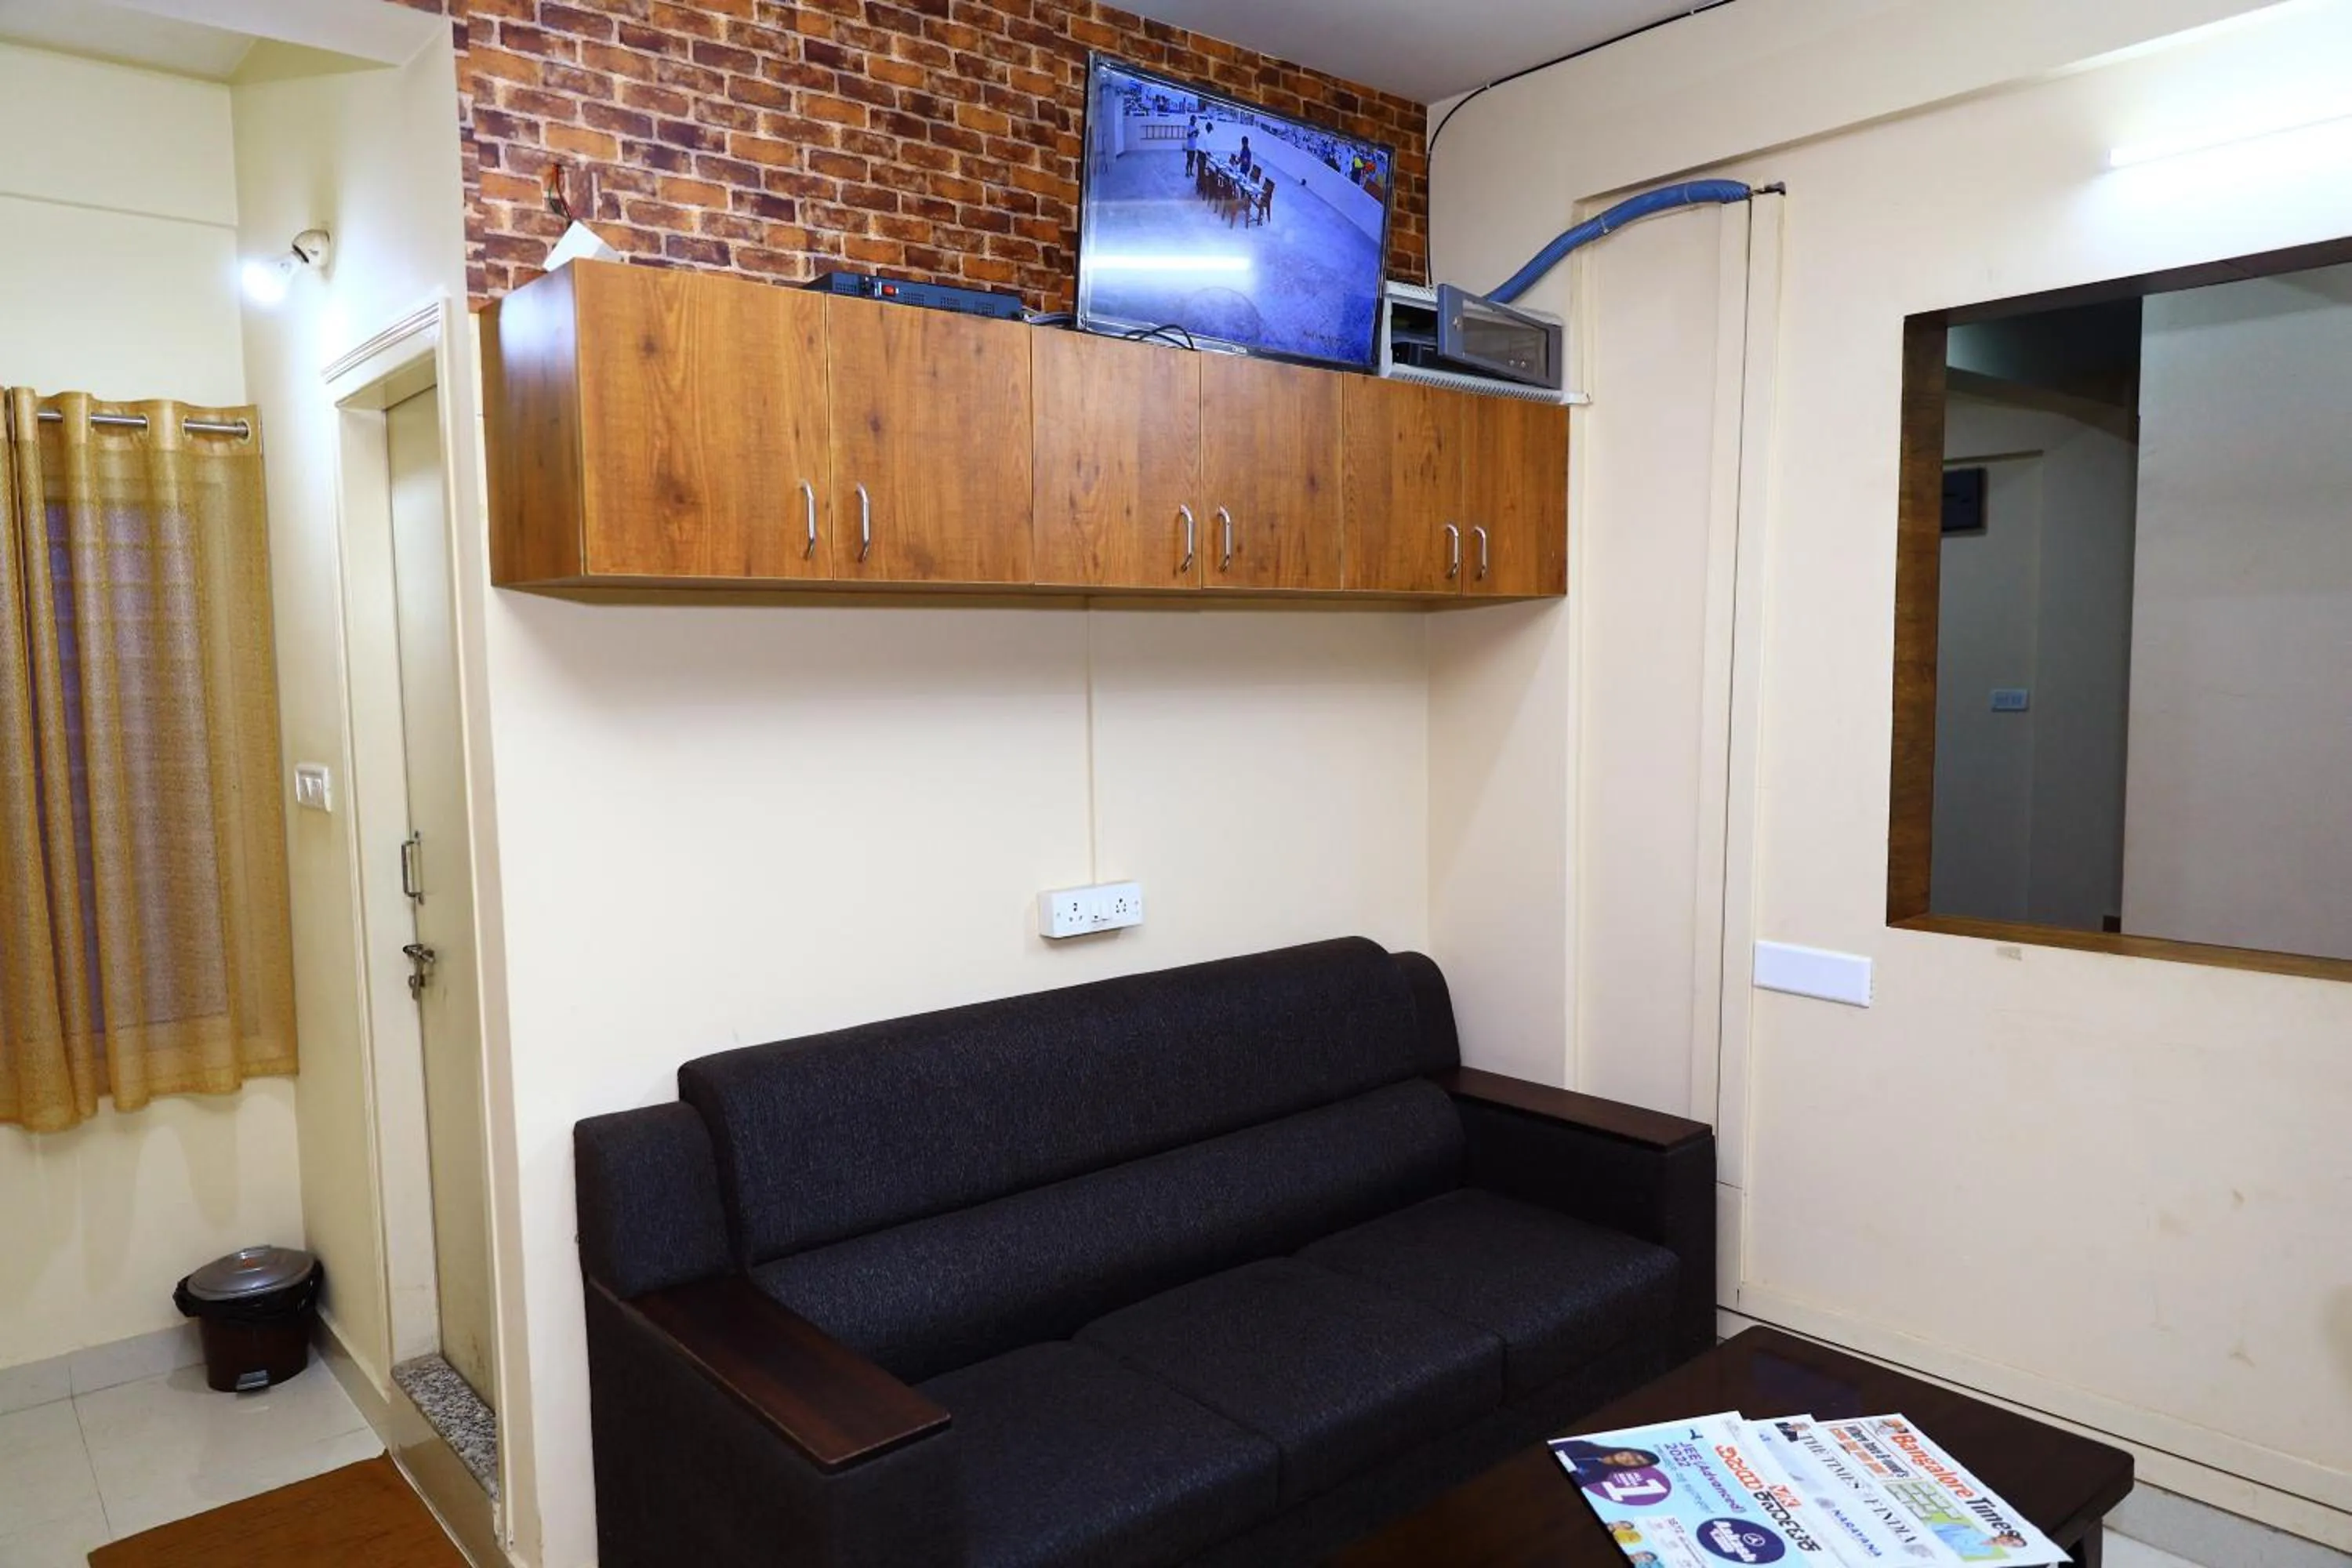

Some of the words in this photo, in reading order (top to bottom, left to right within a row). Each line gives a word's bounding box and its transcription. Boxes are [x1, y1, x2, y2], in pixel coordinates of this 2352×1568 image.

[1664, 1442, 1692, 1468] 2022
[1679, 1442, 1703, 1463] JEE
[1603, 1479, 1668, 1502] 1
[1715, 1444, 1763, 1490] ವಿಜಯ
[1753, 1490, 1823, 1552] ಕರ್ನಾಟಕ
[1890, 1432, 1976, 1498] Bangalore
[1965, 1497, 2022, 1538] Times
